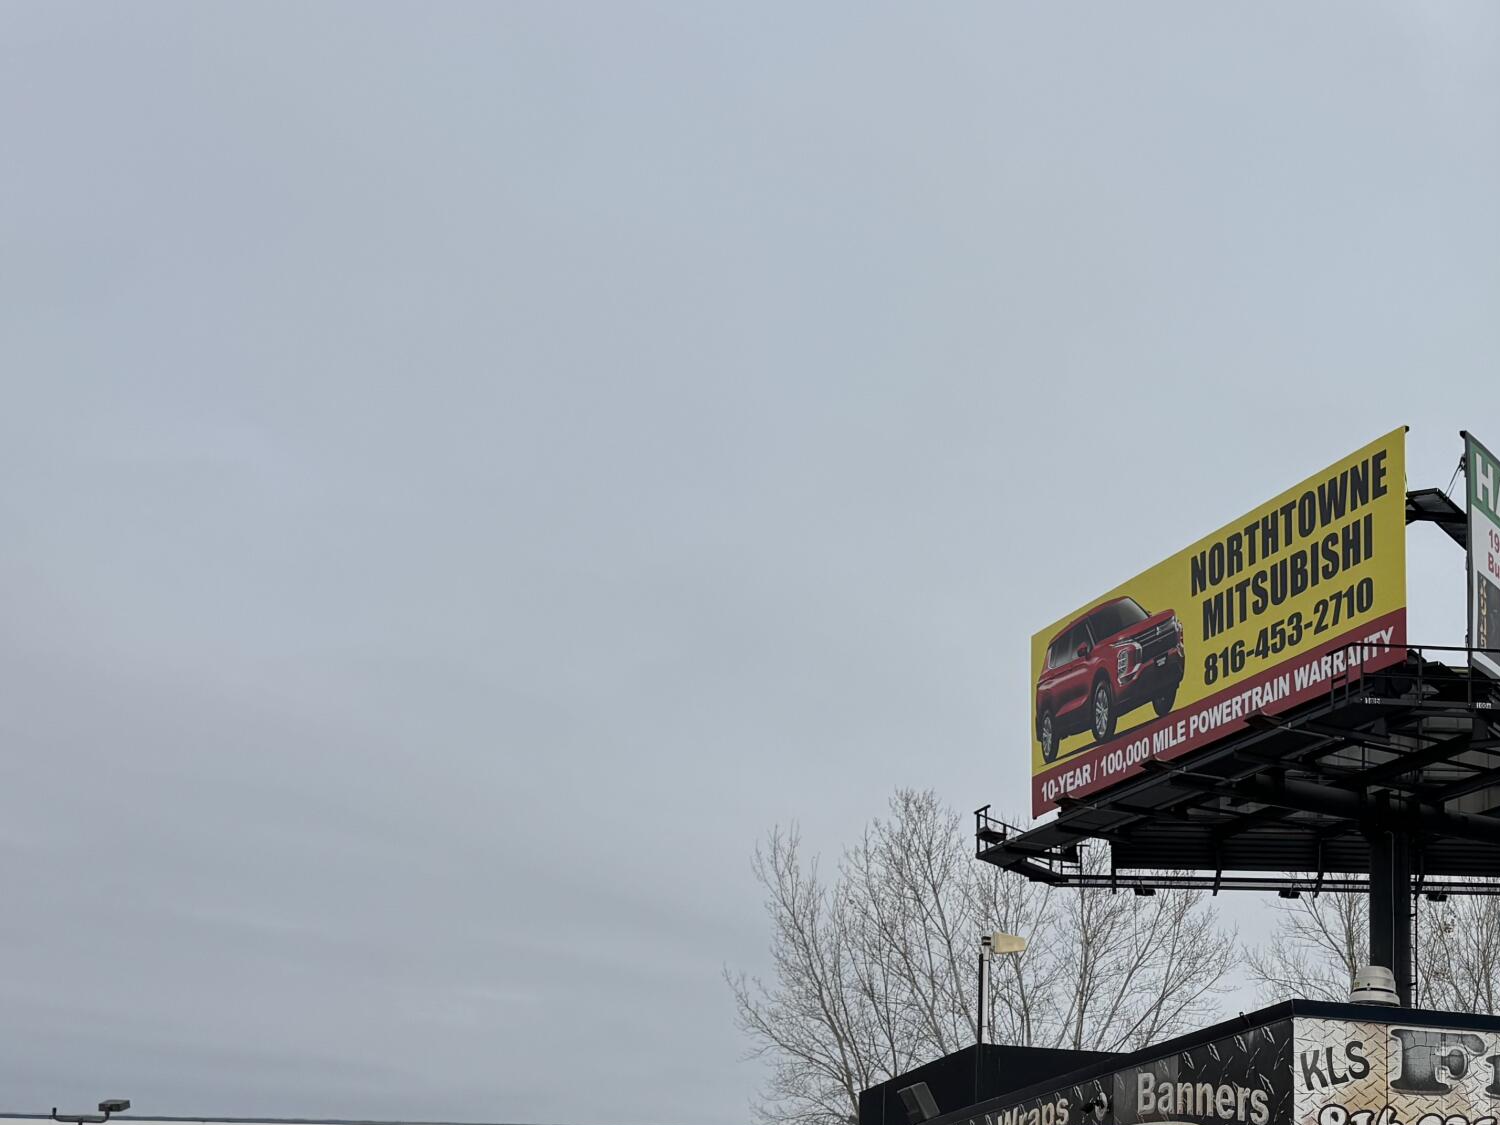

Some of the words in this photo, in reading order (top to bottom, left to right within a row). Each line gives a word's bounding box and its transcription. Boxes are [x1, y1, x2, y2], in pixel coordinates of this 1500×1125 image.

[1190, 449, 1388, 597] NORTHTOWNE
[1202, 513, 1374, 641] MITSUBISHI
[1203, 577, 1374, 686] 816-453-2710
[1041, 767, 1092, 802] 10-YEAR
[1101, 738, 1149, 777] 100,000
[1153, 720, 1186, 752] MILE
[1189, 673, 1290, 738] POWERTRAIN
[1137, 1072, 1270, 1125] Banners
[1300, 1041, 1370, 1091] KLS
